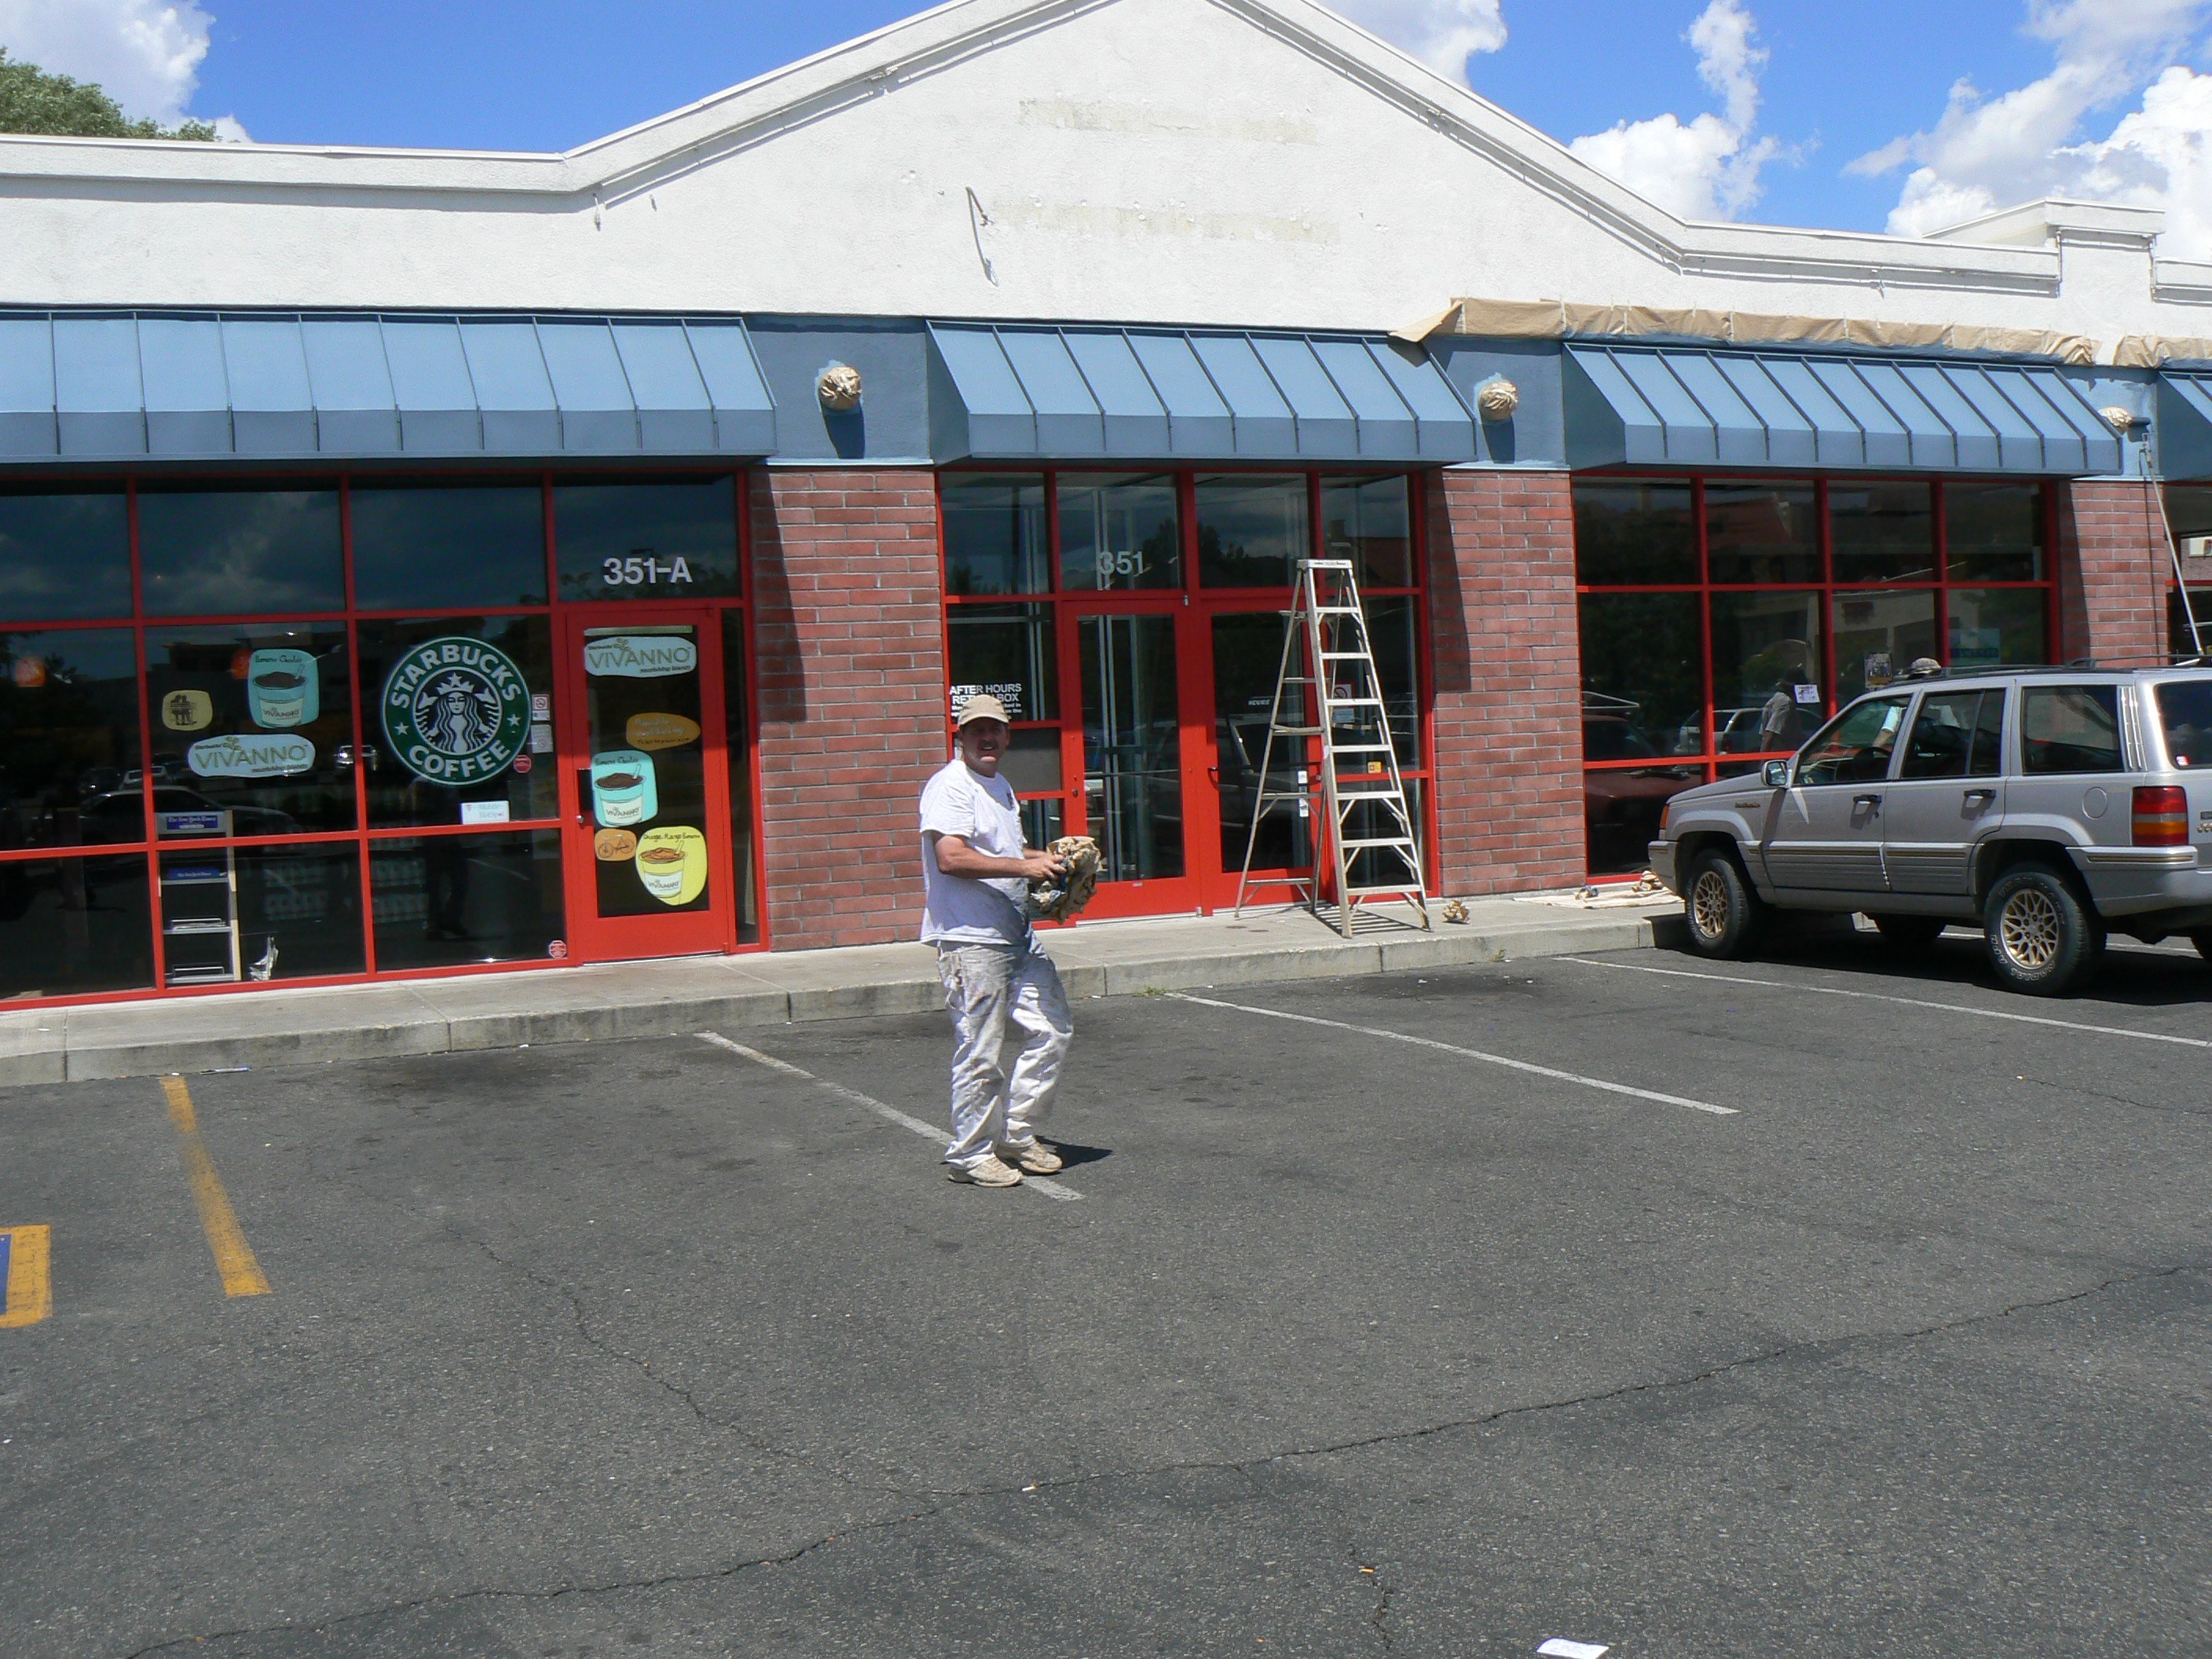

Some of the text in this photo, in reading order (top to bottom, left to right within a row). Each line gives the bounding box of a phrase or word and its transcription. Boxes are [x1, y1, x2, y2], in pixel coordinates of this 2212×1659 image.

[603, 556, 694, 585] 351-A
[1099, 551, 1144, 575] 351
[588, 646, 690, 668] VIVANNO
[392, 644, 521, 709] STARBUCKS
[949, 683, 1022, 694] AFTER HOURS
[996, 693, 1020, 702] BOX
[195, 745, 306, 769] VIVANNO
[408, 740, 511, 778] COFFEE
